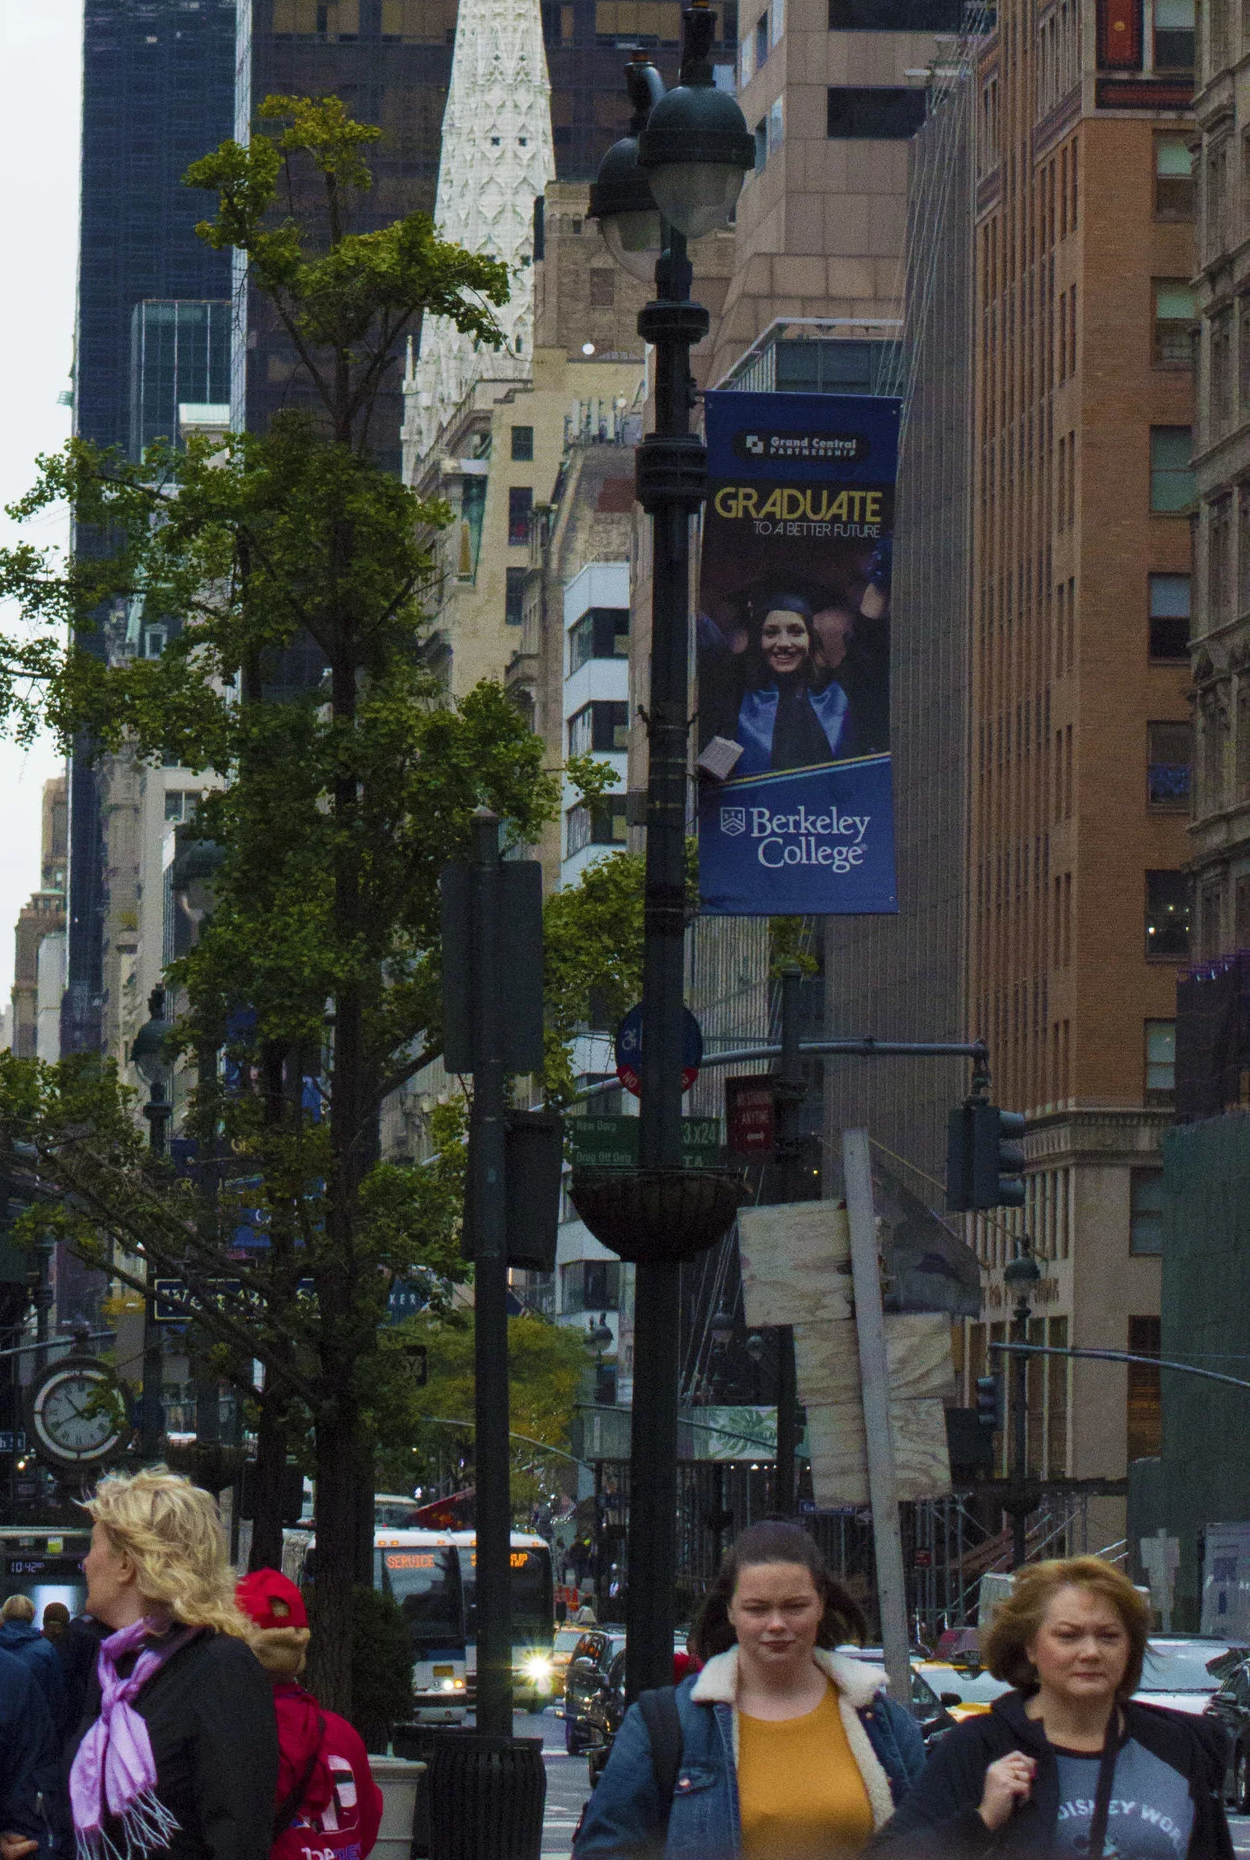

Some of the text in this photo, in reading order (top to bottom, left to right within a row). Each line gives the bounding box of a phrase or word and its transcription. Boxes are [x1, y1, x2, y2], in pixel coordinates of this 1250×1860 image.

[770, 436, 856, 448] Grand Central
[770, 447, 856, 457] PARTNERSHIP
[714, 486, 883, 522] GRADUATE
[753, 521, 881, 538] TO A BETTER FUTURE
[750, 806, 871, 843] Berkeley
